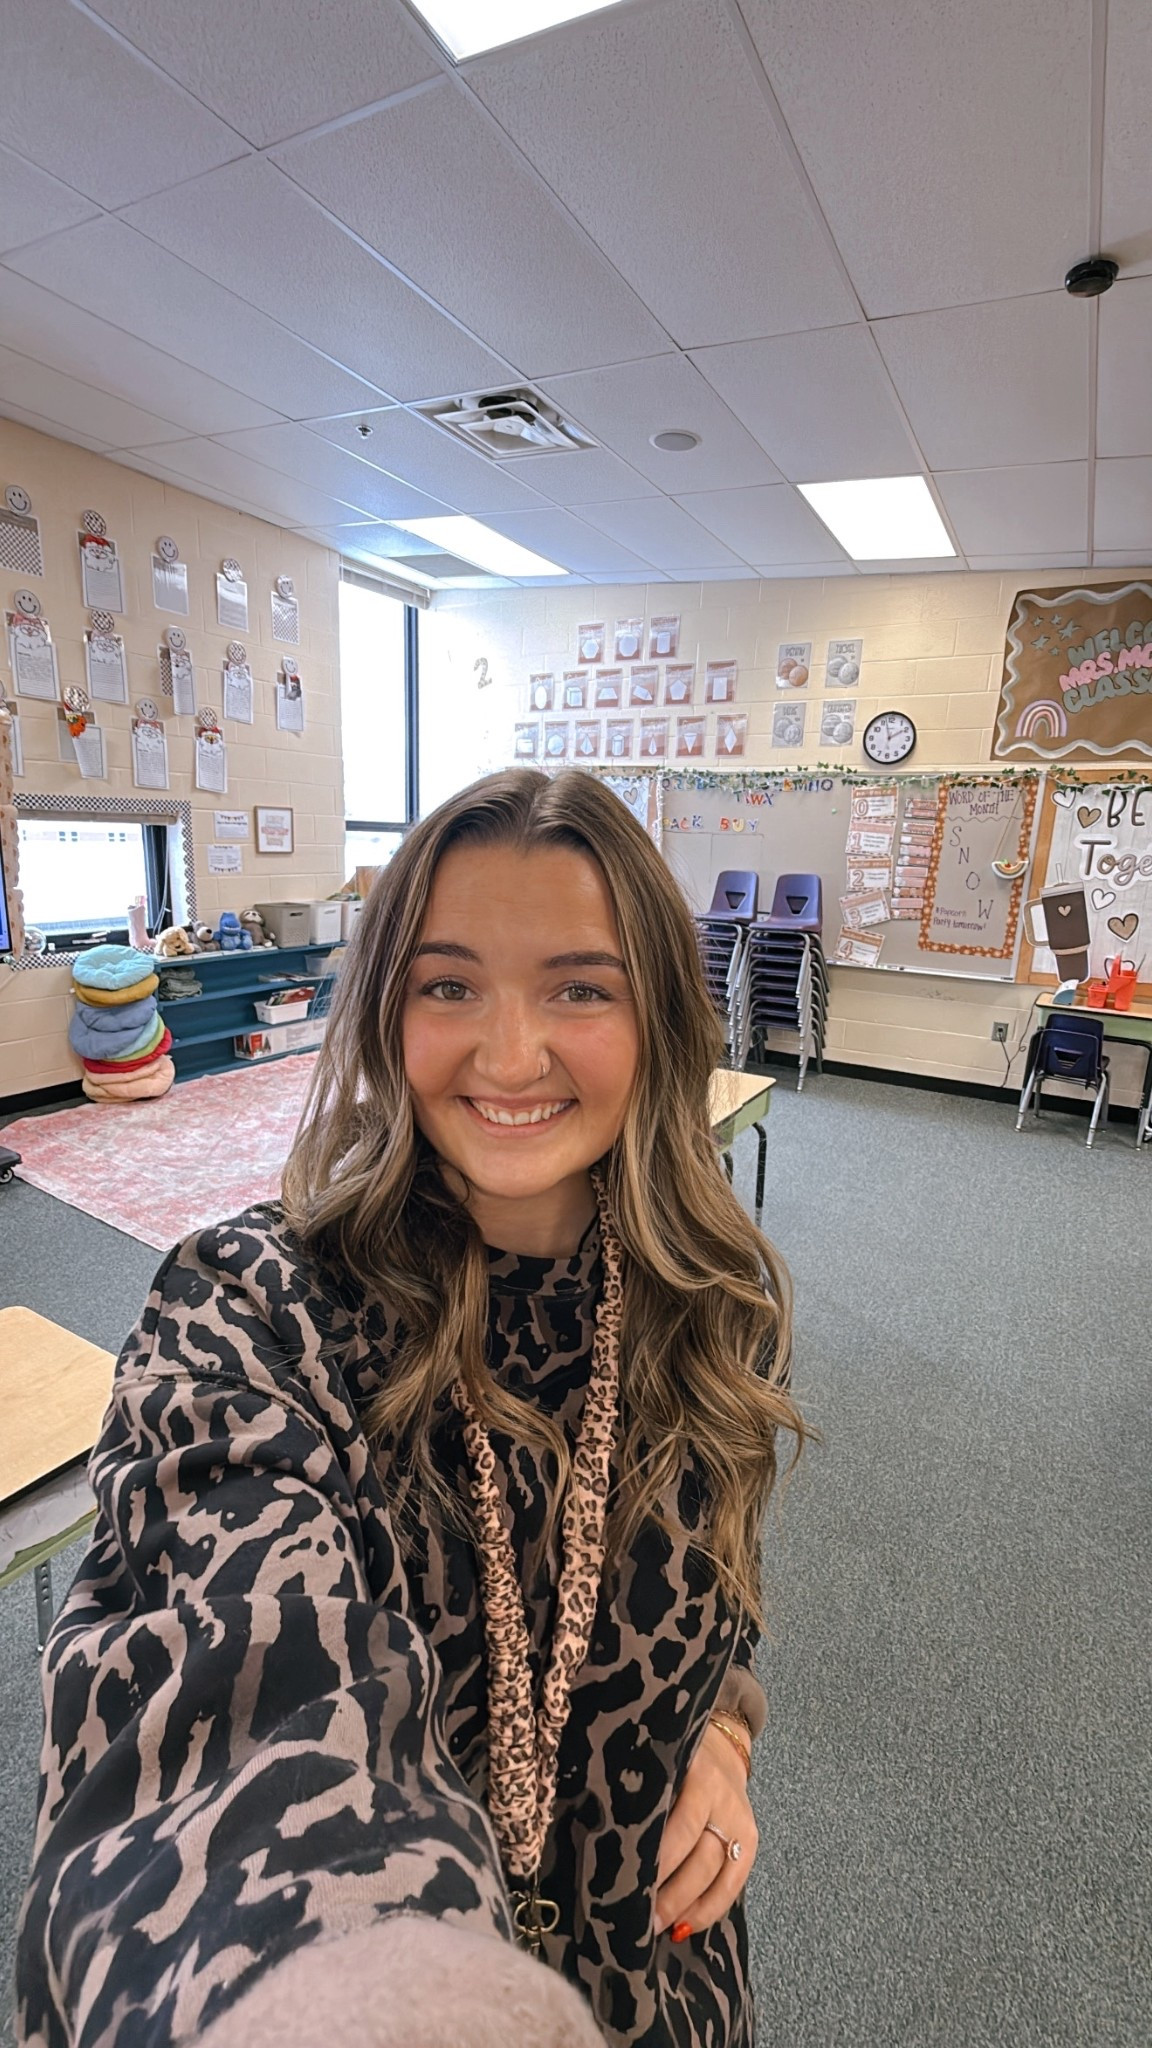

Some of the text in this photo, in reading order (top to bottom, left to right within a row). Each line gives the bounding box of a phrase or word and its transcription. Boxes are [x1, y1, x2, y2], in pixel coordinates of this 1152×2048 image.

[473, 657, 493, 690] 2
[949, 789, 1014, 805] WORD OF THE
[854, 799, 869, 817] 0
[969, 802, 999, 816] MONTH
[720, 817, 758, 832] BUY
[851, 833, 863, 851] 1
[852, 869, 865, 888] 2
[850, 909, 861, 927] 3
[840, 940, 853, 957] 4
